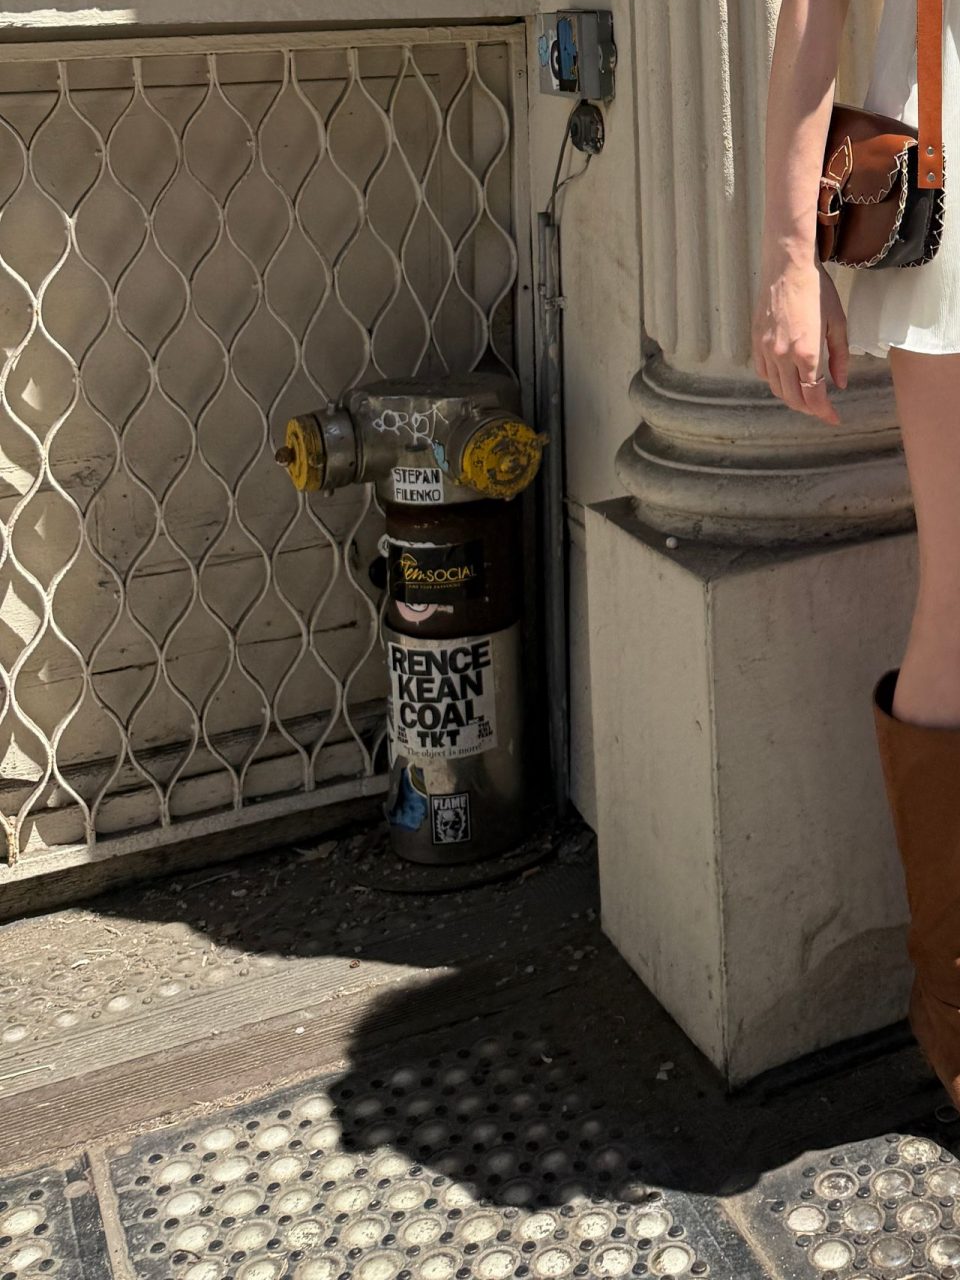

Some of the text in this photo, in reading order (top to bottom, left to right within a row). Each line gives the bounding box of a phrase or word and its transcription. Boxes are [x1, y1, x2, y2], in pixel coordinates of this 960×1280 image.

[394, 468, 440, 484] STEPAN
[395, 487, 441, 501] FILENKO
[391, 640, 491, 676] RENCE
[398, 670, 483, 703] KEAN
[400, 699, 484, 730] COAL
[417, 729, 460, 748] TKT
[434, 796, 466, 810] FLAME
